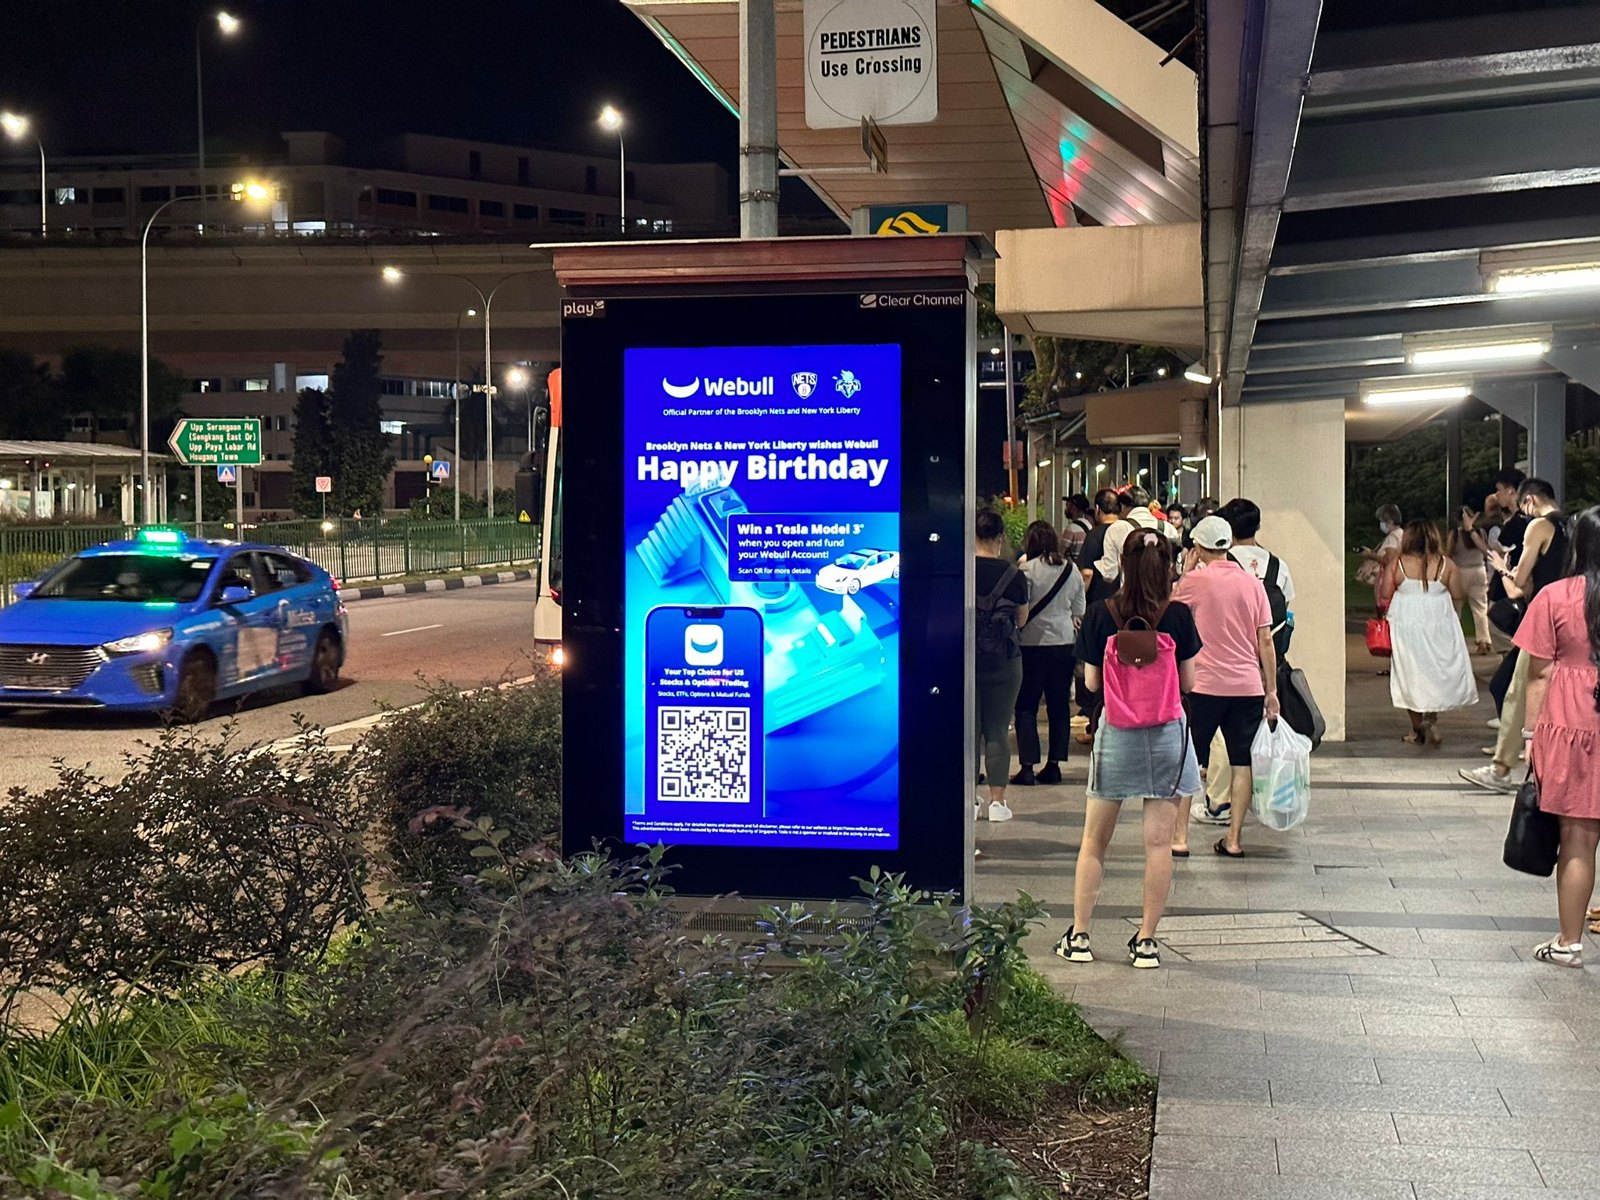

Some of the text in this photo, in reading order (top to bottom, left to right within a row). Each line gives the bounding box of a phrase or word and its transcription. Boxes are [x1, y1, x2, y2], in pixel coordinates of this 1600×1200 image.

[821, 26, 920, 49] PEDESTRIANS
[821, 55, 921, 77] Use Crossing
[879, 294, 963, 306] Clear Channel
[564, 302, 594, 317] play
[793, 375, 816, 385] NETS
[704, 376, 773, 396] Webull
[716, 407, 723, 415] of
[738, 407, 768, 416] Brooklyn
[819, 406, 835, 414] York
[837, 407, 861, 415] Liberty
[190, 423, 204, 431] Upp
[206, 423, 242, 432] Serangoon
[189, 433, 256, 442] (Sengkang East Dr)
[189, 443, 202, 452] Upp
[205, 443, 222, 452] Paya
[646, 440, 878, 453] Brooklyn Nets & New York Liberty wishes Webull
[189, 453, 218, 462] Hougang
[637, 453, 888, 488] Happy Birthday
[737, 524, 762, 535] Win
[765, 526, 773, 535] a
[775, 524, 808, 535] Tesla
[811, 524, 850, 534] Model
[738, 538, 844, 550] when you open and fund
[738, 551, 829, 561] your Webull Account!
[738, 567, 753, 575] Scan
[754, 567, 763, 575] QR
[664, 668, 744, 677] Your Top Choice for US
[660, 678, 683, 686] Stocks
[692, 679, 720, 687] Options
[721, 679, 749, 688] Trading
